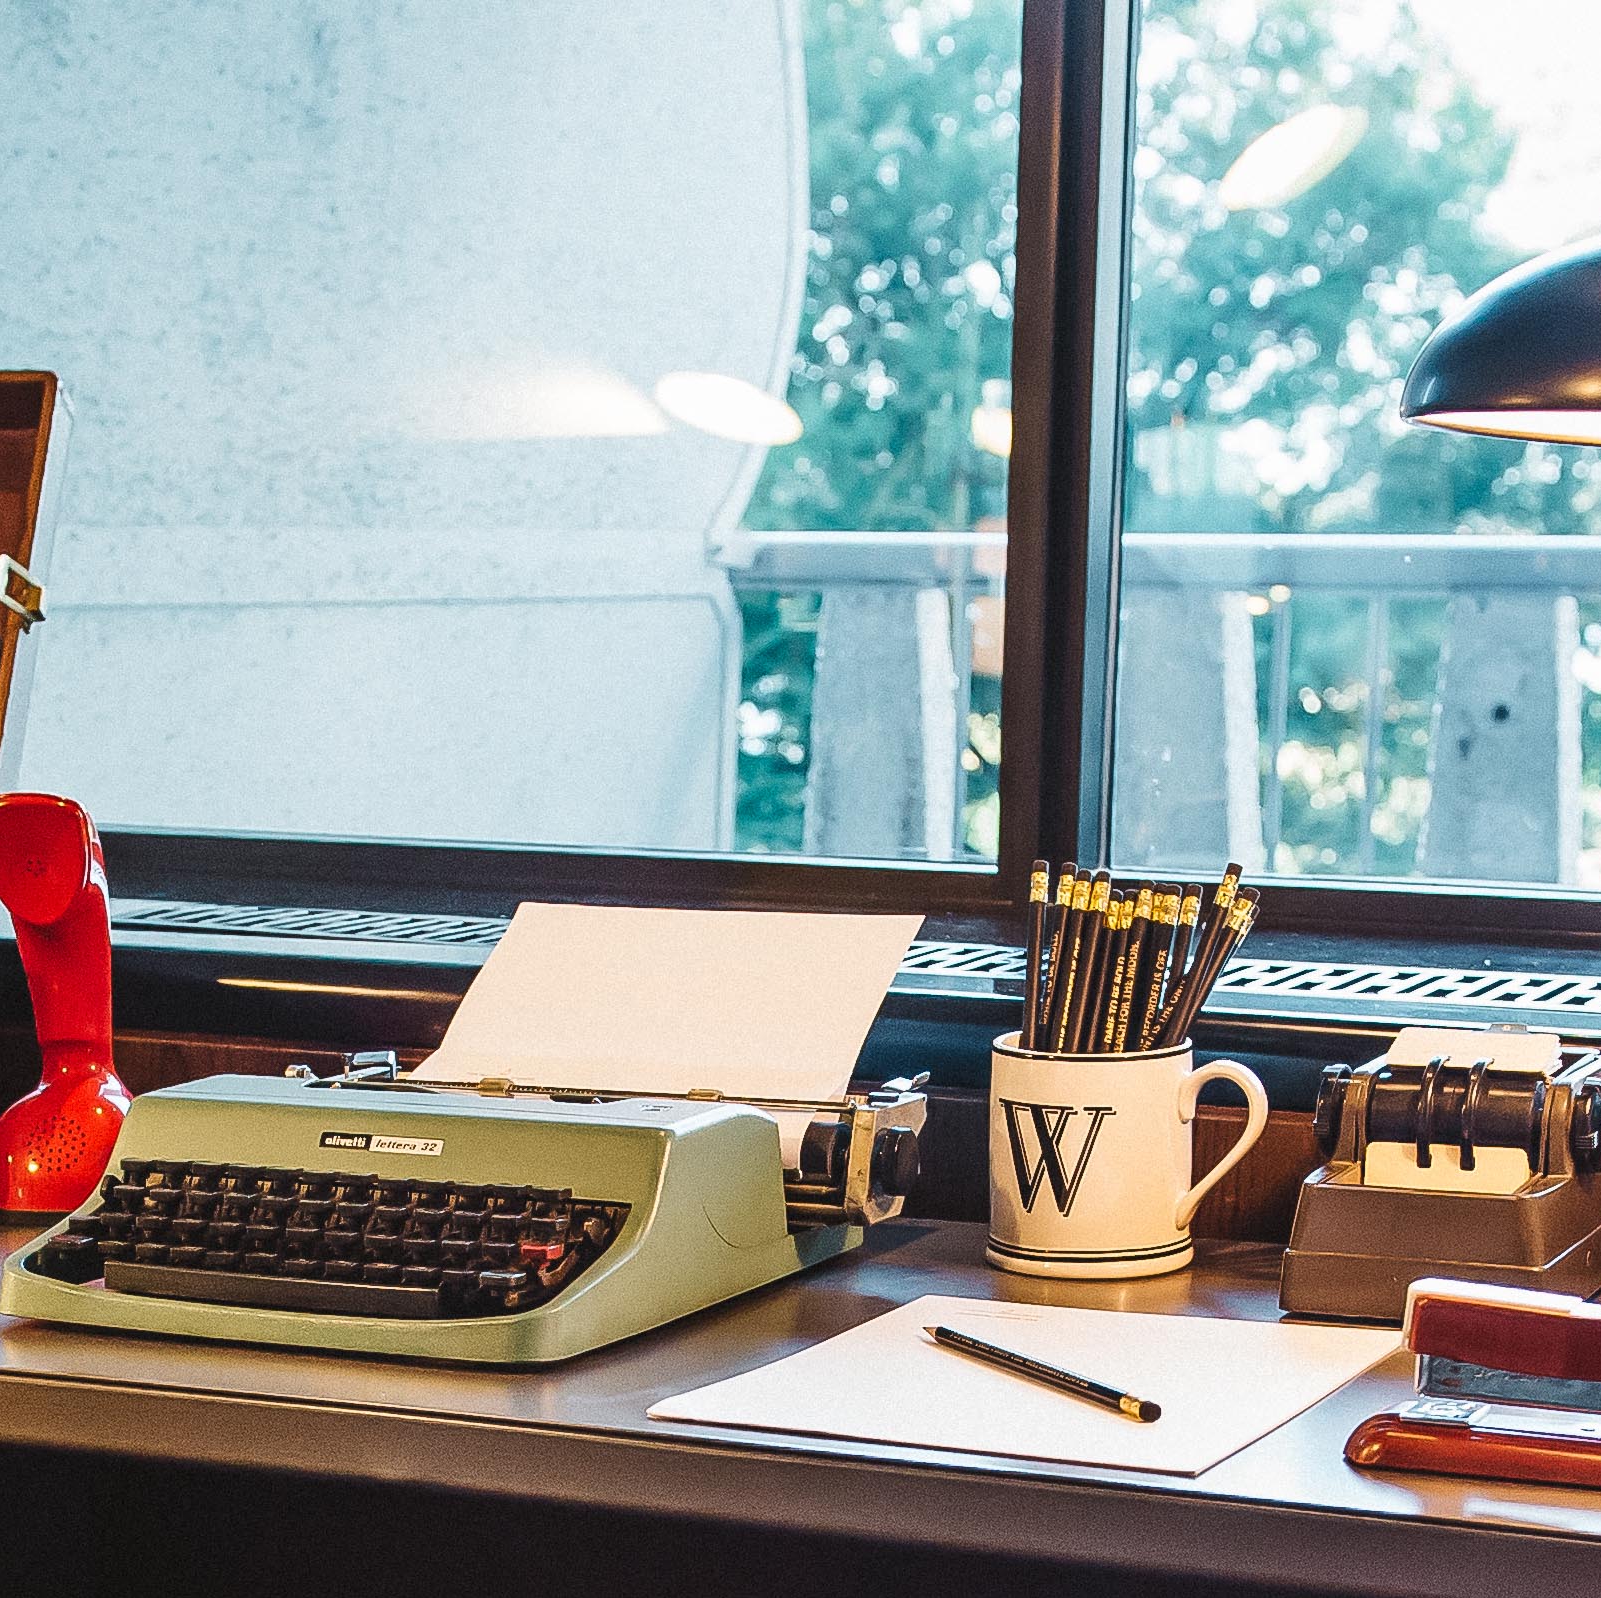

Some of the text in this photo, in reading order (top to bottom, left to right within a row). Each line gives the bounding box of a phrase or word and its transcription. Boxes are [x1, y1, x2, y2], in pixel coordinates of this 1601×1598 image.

[324, 1135, 438, 1152] olivetti lettera 32
[999, 1098, 1116, 1217] W
